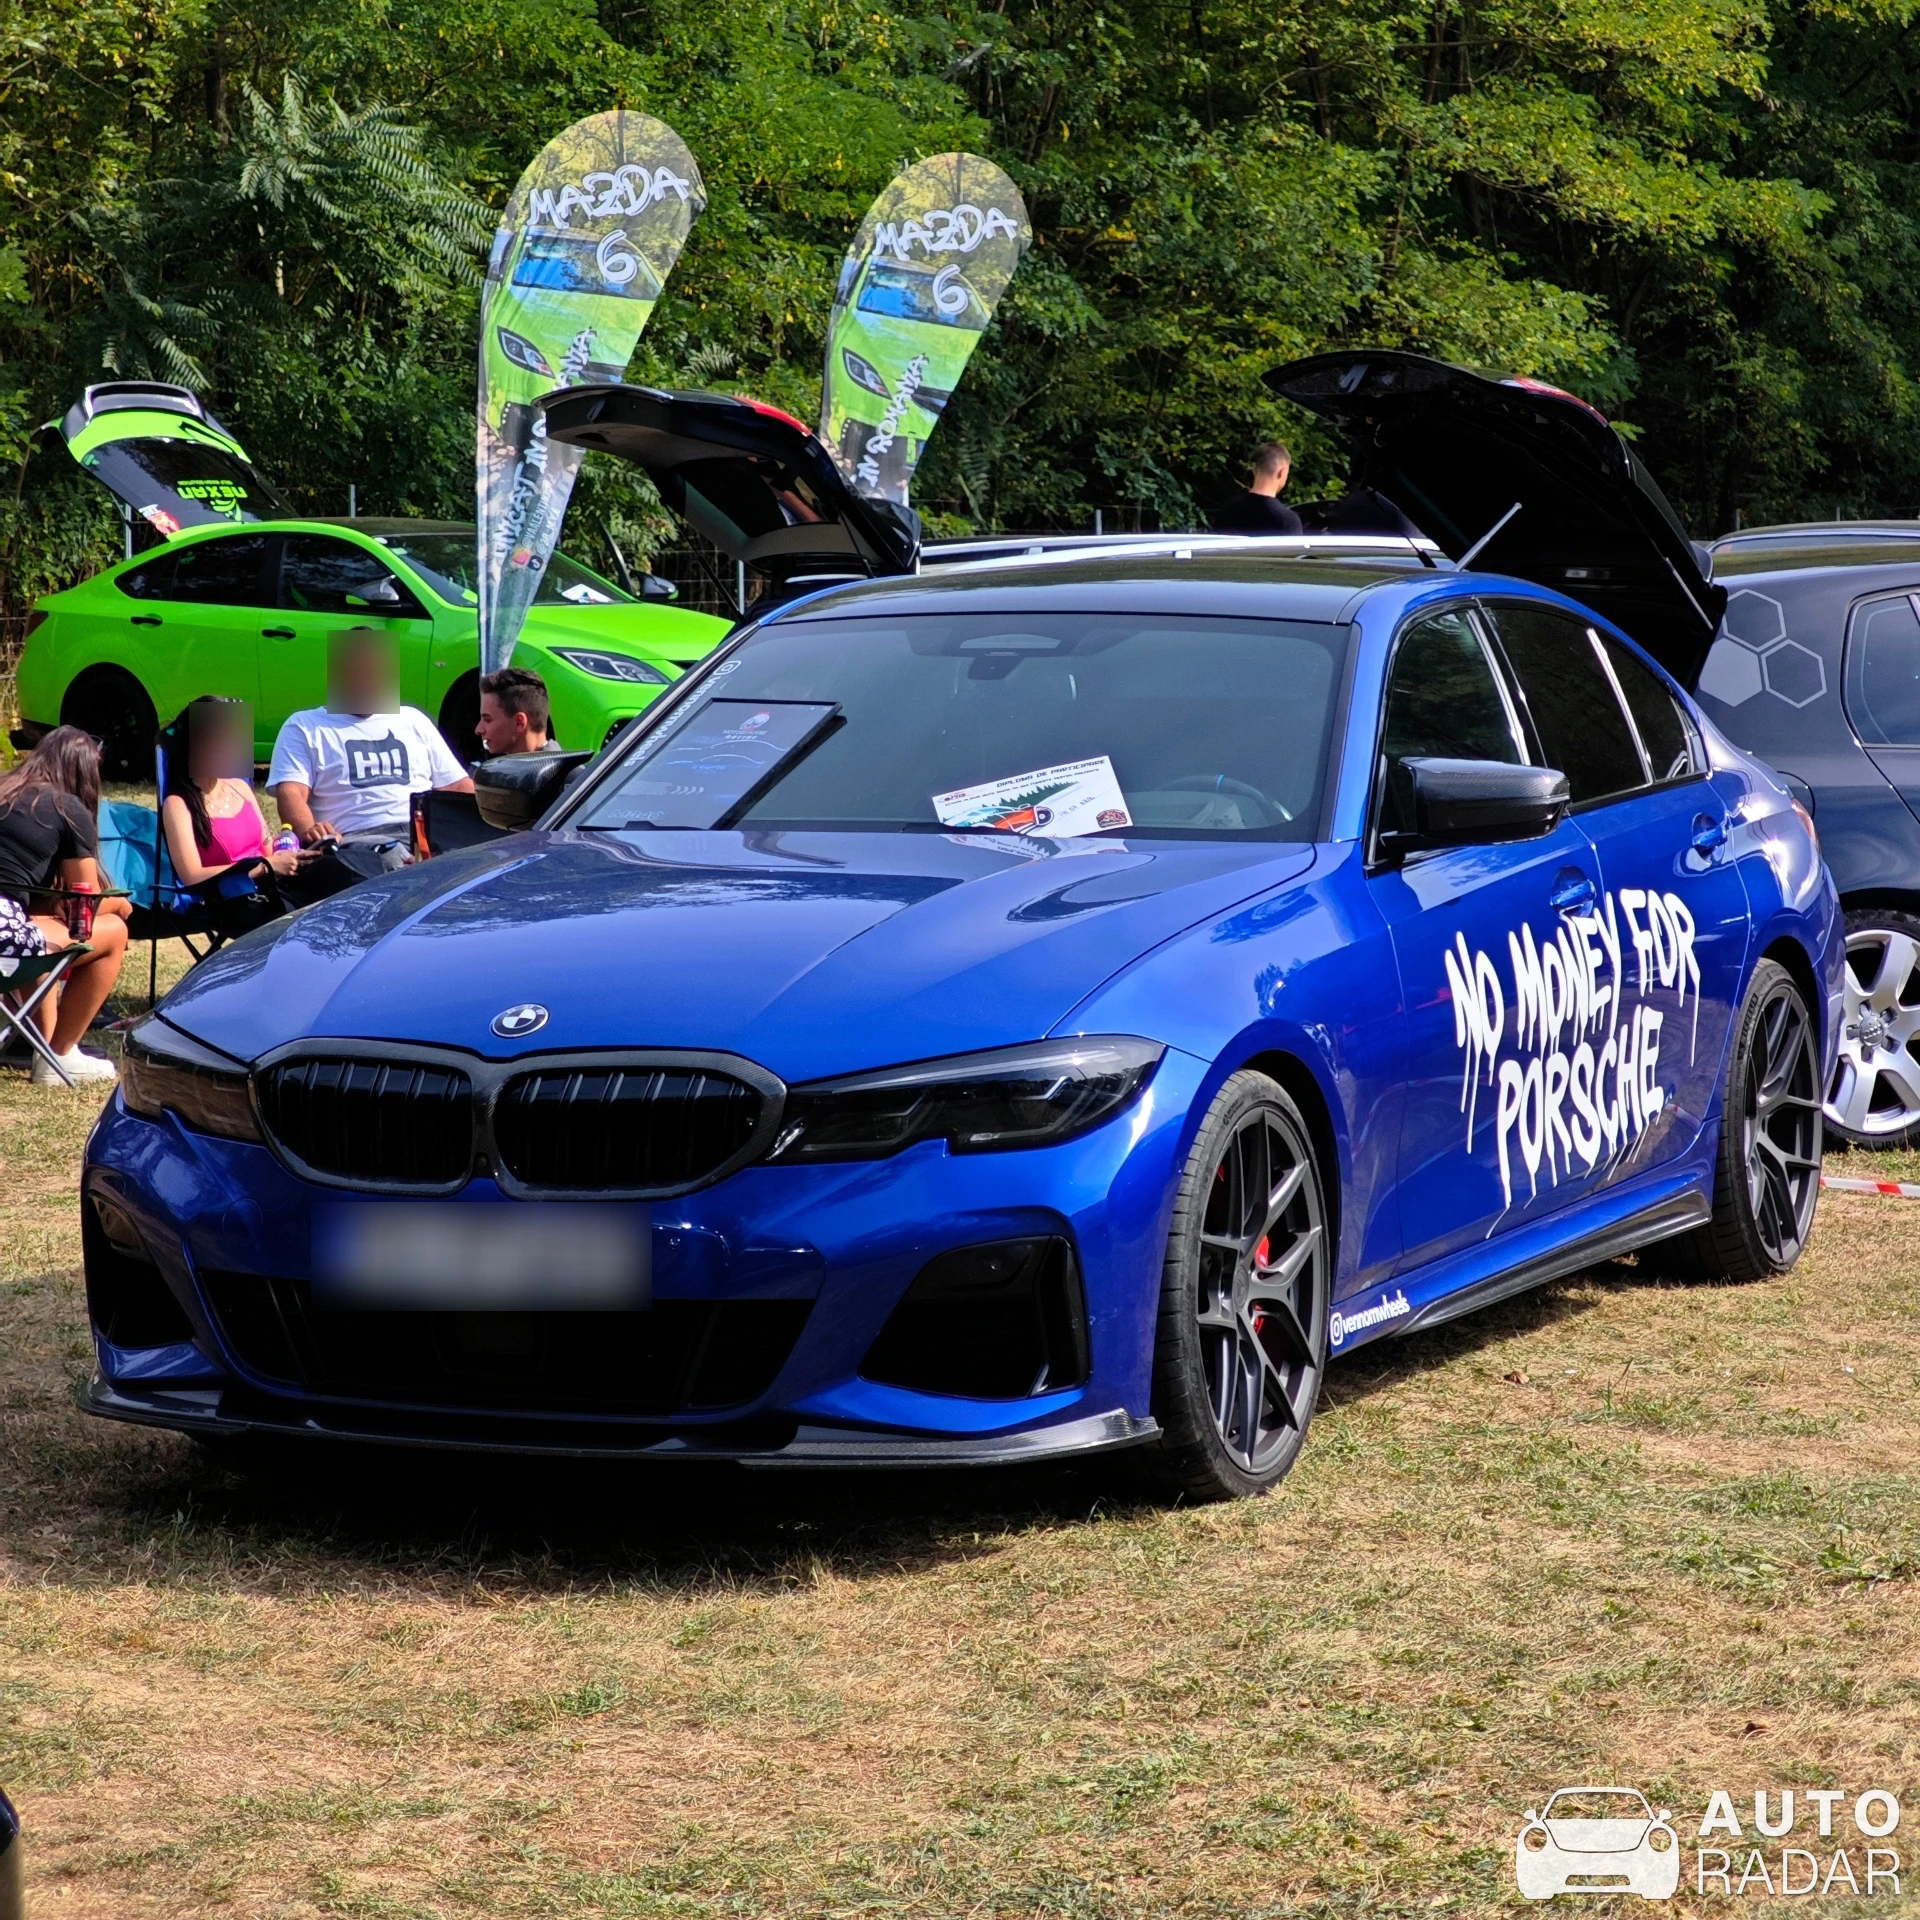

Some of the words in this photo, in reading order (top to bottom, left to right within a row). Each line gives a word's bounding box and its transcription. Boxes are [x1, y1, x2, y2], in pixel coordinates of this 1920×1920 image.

[527, 164, 689, 230] MAZDA
[597, 229, 638, 284] 6
[872, 204, 1018, 261] MAZDA
[932, 264, 968, 315] 6
[866, 353, 930, 454] ROMANIA
[524, 439, 548, 474] IN
[857, 454, 880, 488] IN
[353, 748, 403, 779] HI!
[996, 775, 1033, 788] DIPLOMA
[1036, 771, 1048, 779] DE
[1444, 931, 1505, 1154] NO
[1508, 891, 1623, 1062] MONEY
[1619, 888, 1701, 1068] FOR
[1486, 1004, 1664, 1240] PORSCHE
[1342, 1289, 1411, 1334] vennomwheels
